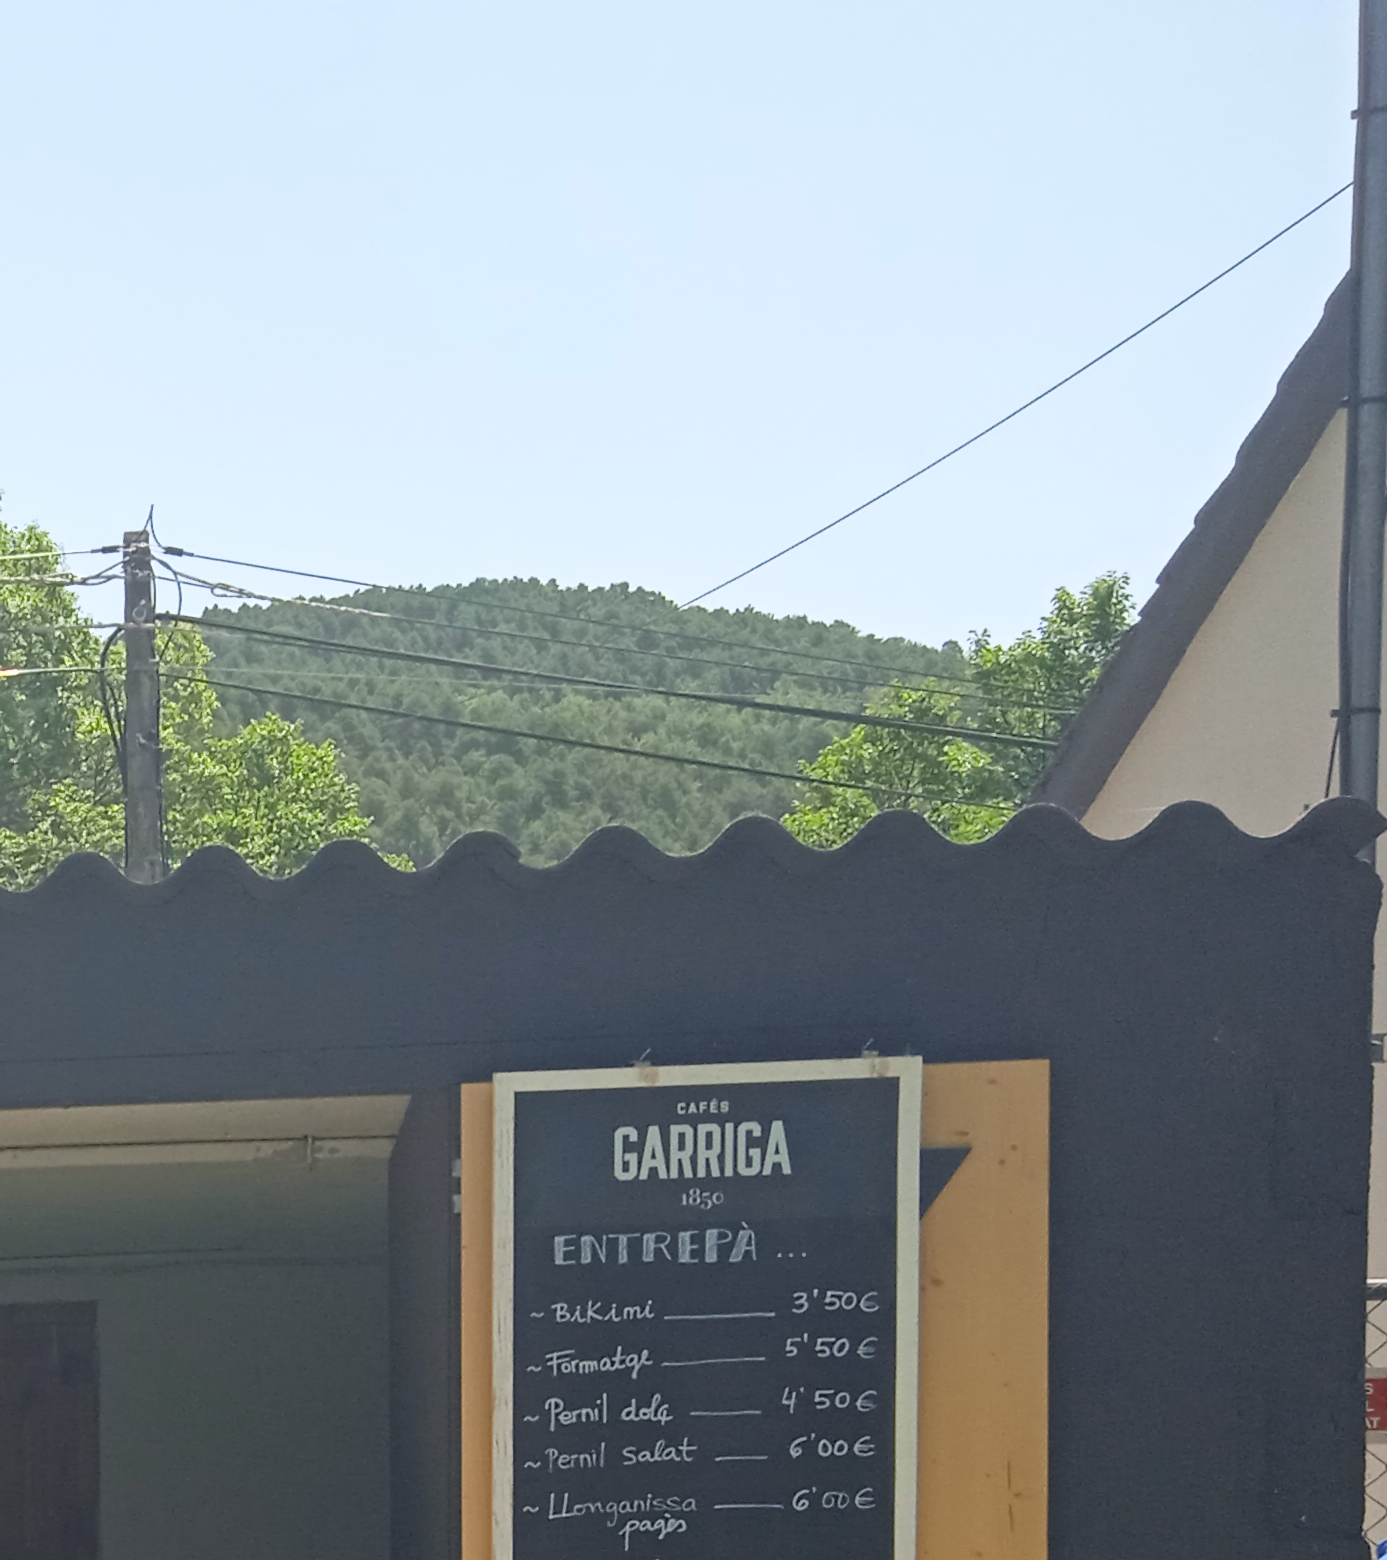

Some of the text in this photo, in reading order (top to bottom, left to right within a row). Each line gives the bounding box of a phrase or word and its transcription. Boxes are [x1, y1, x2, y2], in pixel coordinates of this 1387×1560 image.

[676, 1099, 729, 1115] CAFÉS
[613, 1119, 792, 1181] GARRIGA
[680, 1189, 725, 1210] 1850
[553, 1221, 758, 1266] ENTREPÀ
[545, 1345, 654, 1380] Formatge
[544, 1392, 608, 1432] Pernil
[544, 1441, 606, 1474] Pernil
